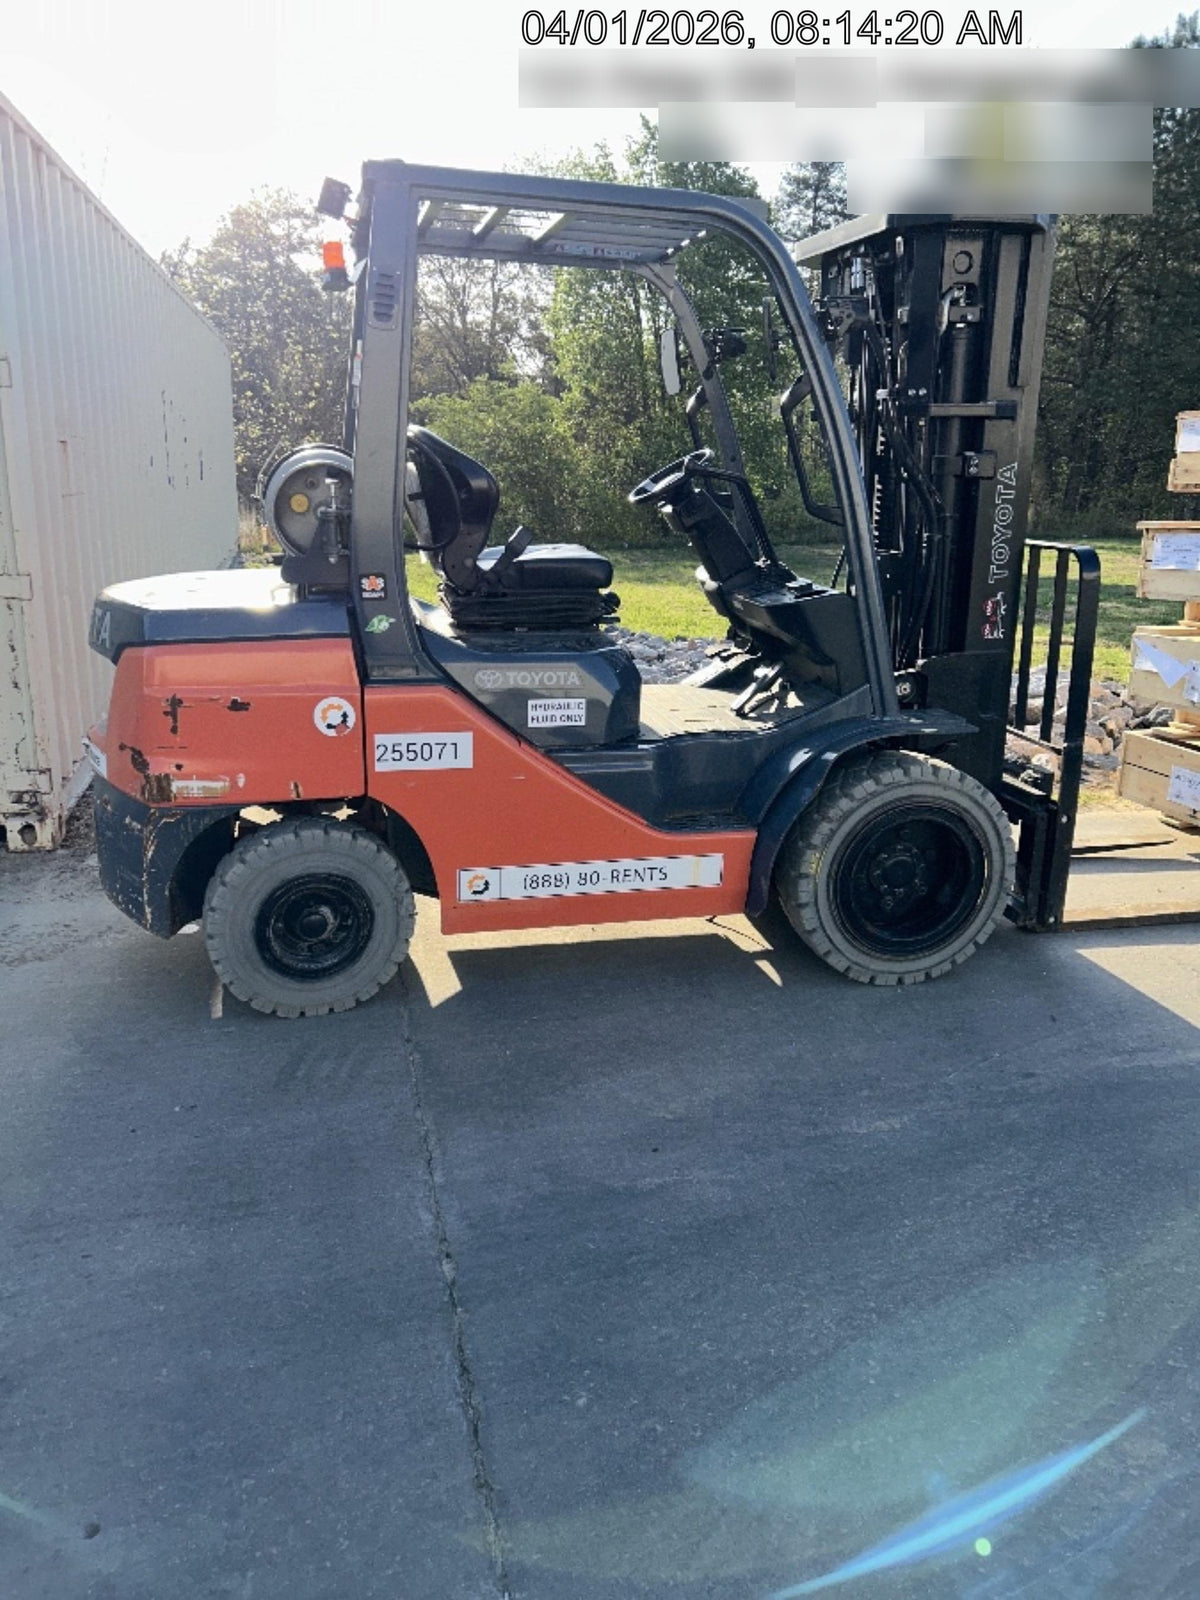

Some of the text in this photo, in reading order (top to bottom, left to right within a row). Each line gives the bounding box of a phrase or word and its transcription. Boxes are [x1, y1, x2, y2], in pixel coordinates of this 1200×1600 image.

[988, 461, 1018, 584] TOYOTA
[505, 671, 581, 686] TOYOTA
[376, 742, 458, 762] 255071
